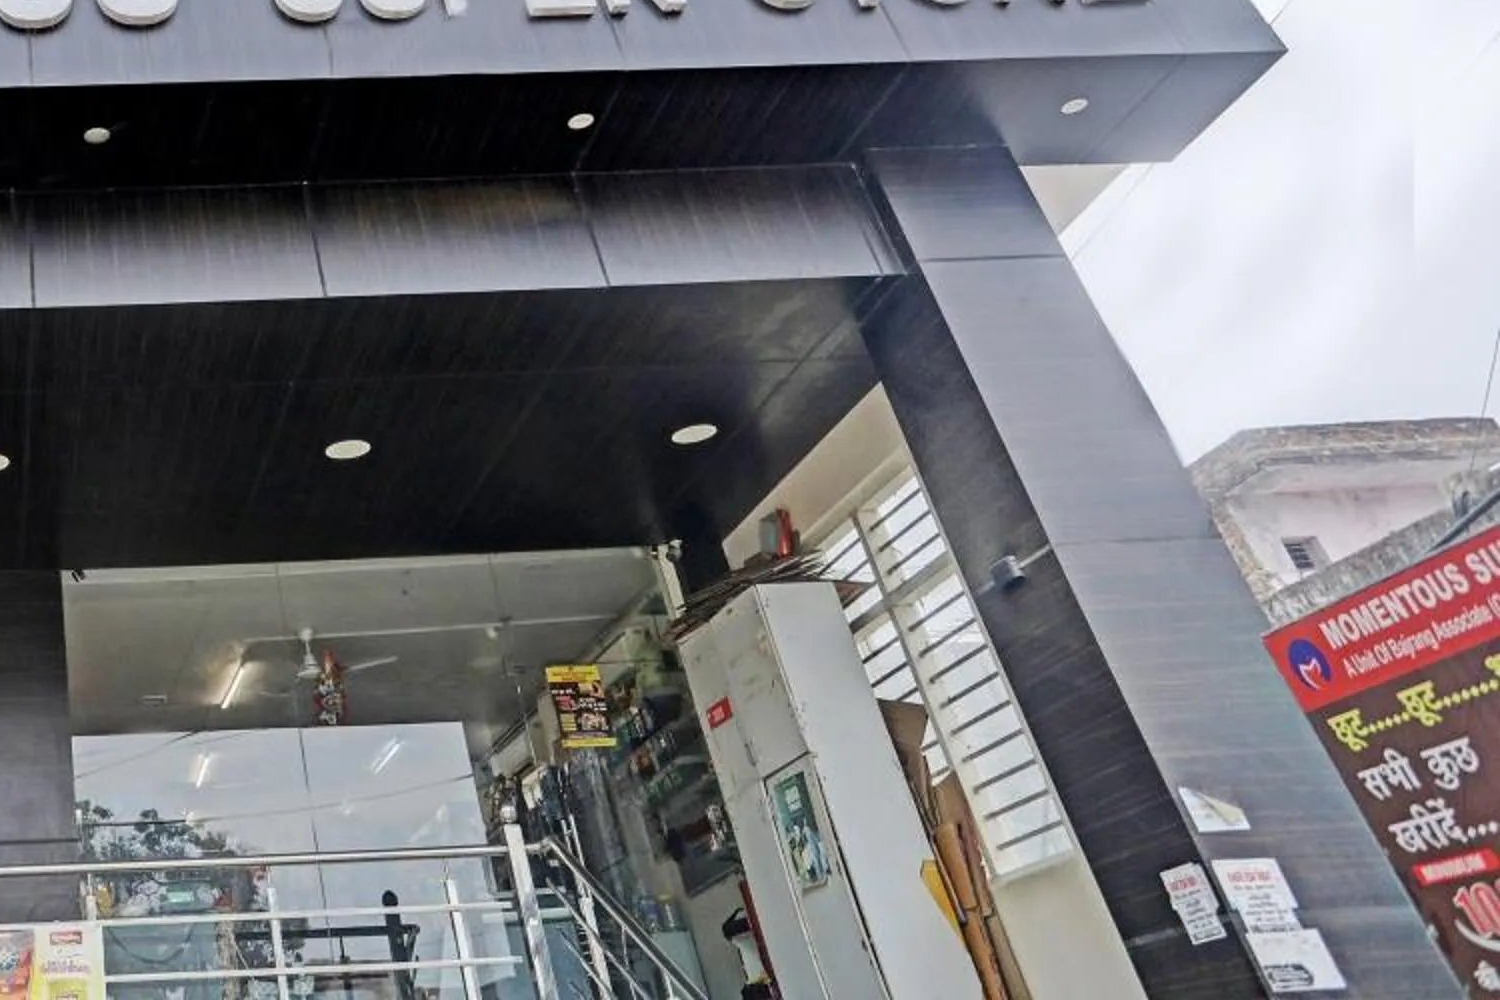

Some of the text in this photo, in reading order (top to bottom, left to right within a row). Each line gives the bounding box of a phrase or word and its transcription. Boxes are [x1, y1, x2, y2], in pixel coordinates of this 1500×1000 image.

[1318, 563, 1470, 650] MOMENTOUS
[1356, 735, 1481, 801] सभी कुछ
